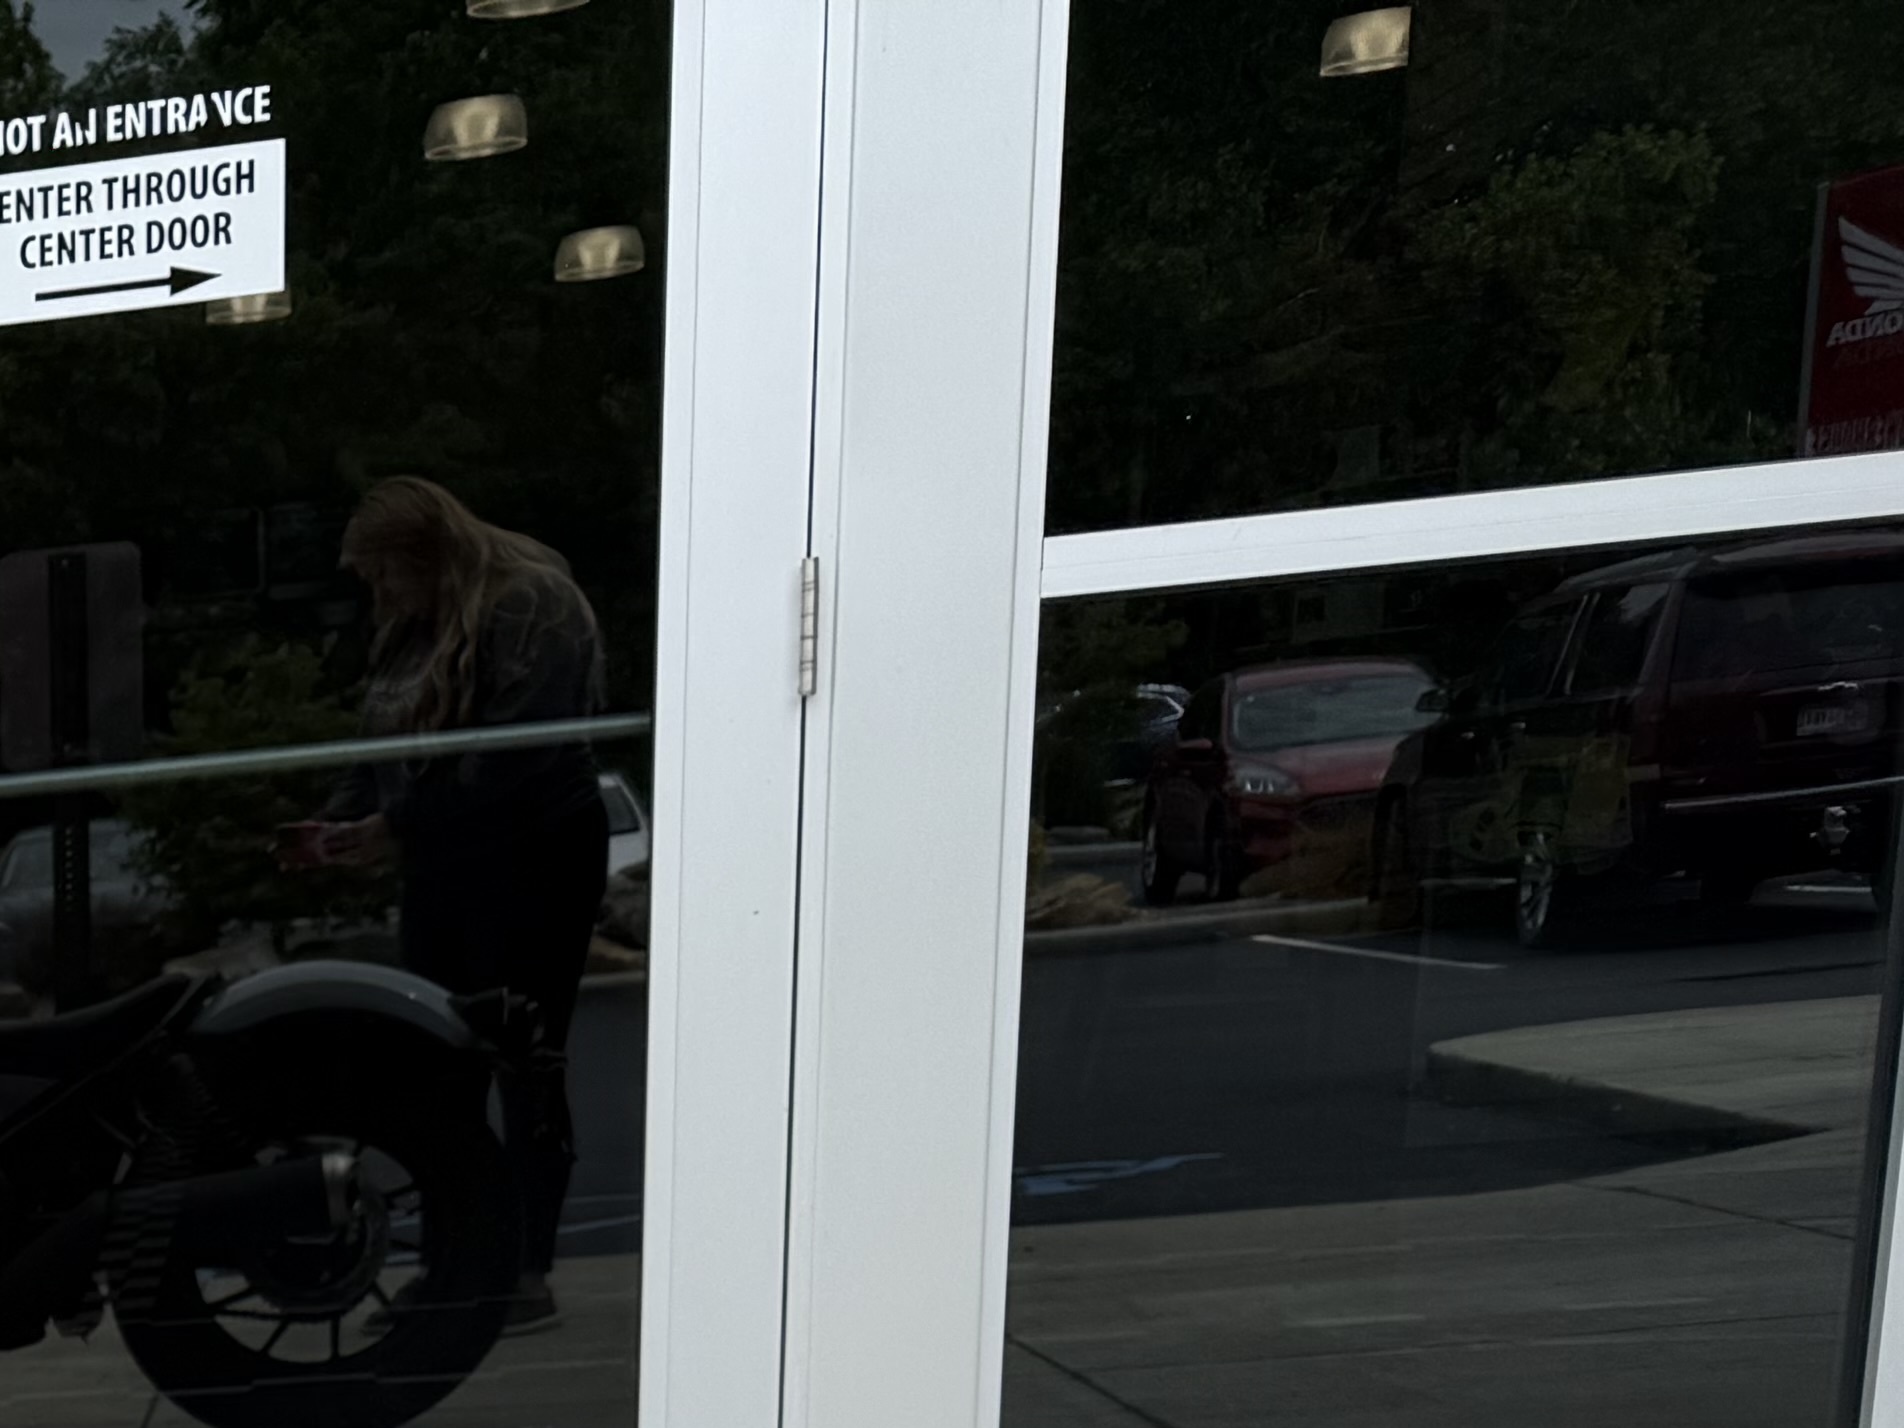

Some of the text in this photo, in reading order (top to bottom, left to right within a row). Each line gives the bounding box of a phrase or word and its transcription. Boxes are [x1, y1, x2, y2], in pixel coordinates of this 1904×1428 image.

[52, 108, 97, 150] AN
[102, 159, 255, 212] THROUGH
[20, 211, 232, 269] CENTER DOOR
